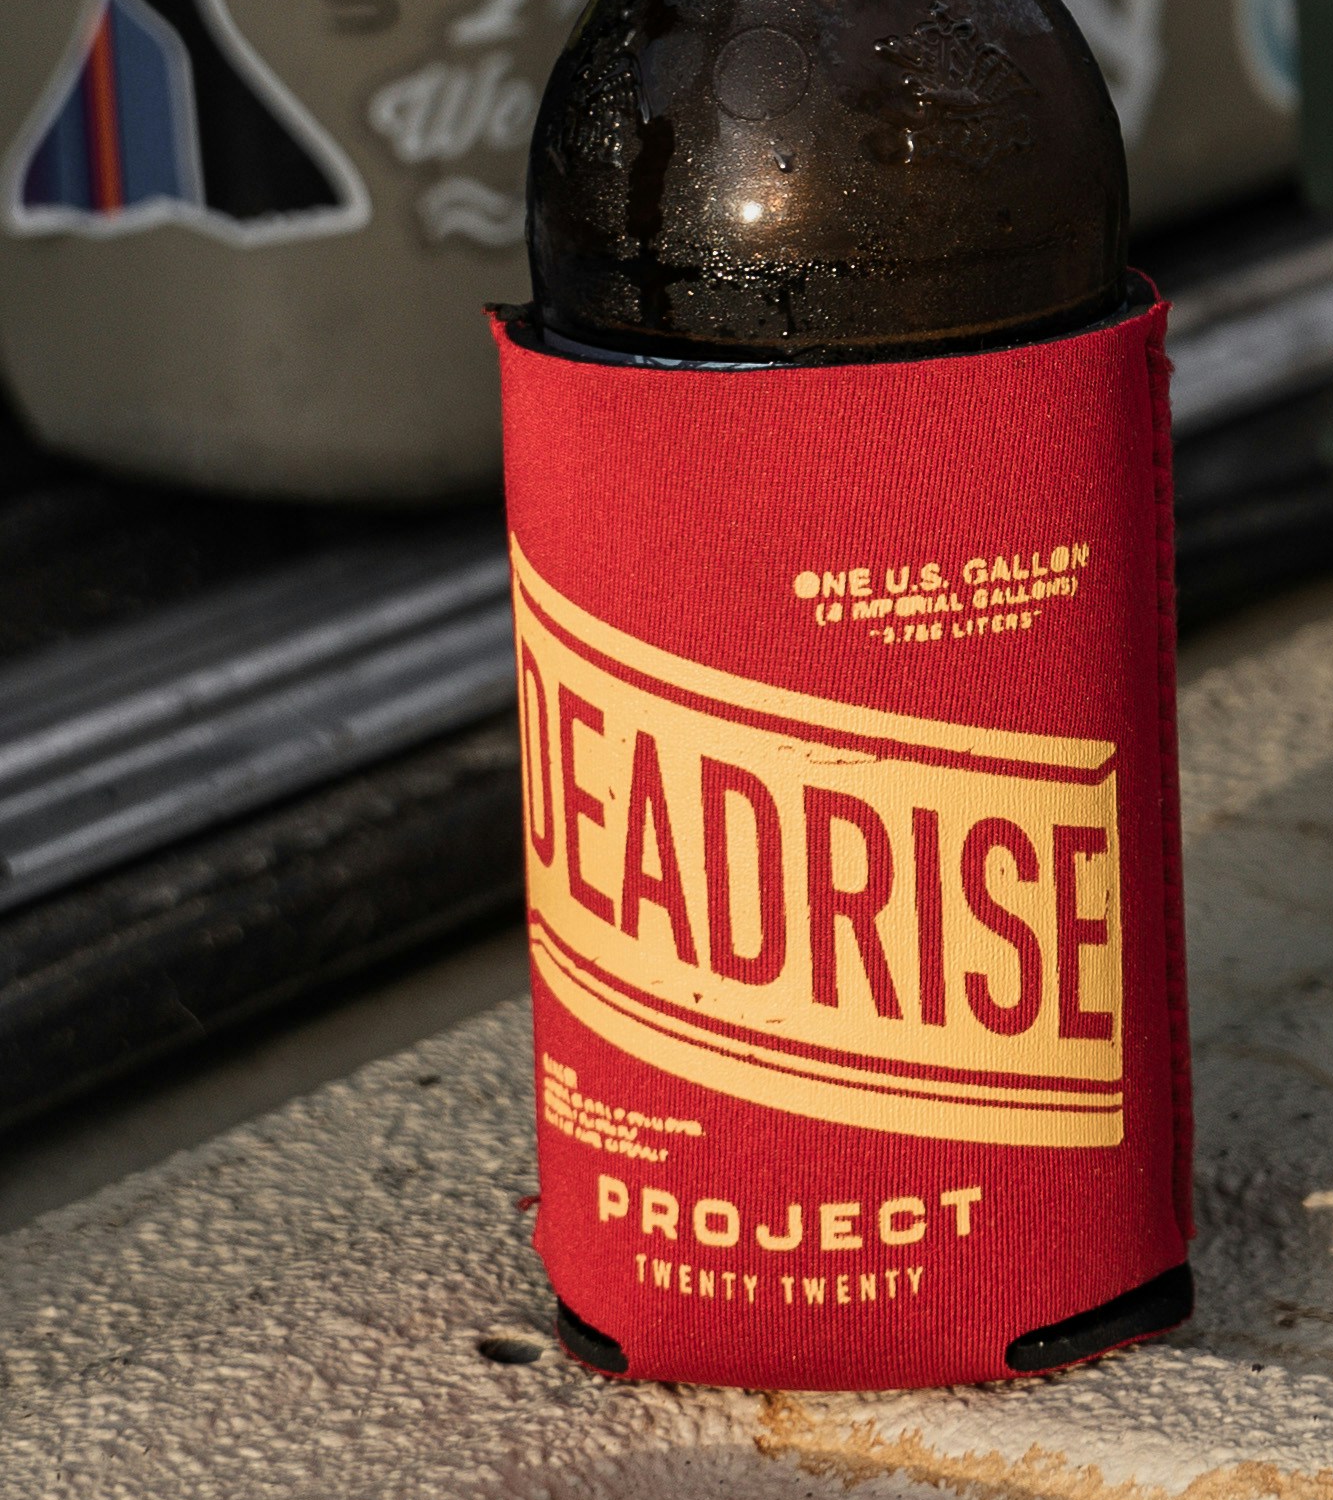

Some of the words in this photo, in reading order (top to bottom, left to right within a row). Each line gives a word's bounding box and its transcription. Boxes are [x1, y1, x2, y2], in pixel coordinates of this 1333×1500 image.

[793, 567, 872, 599] ONE
[885, 562, 949, 594] U.S.
[962, 542, 1090, 586] GALLON
[521, 637, 1113, 1041] DEADRISE
[598, 1174, 982, 1251] PROJECT
[636, 1252, 758, 1303] TWENTY
[781, 1266, 923, 1304] TWENTY
